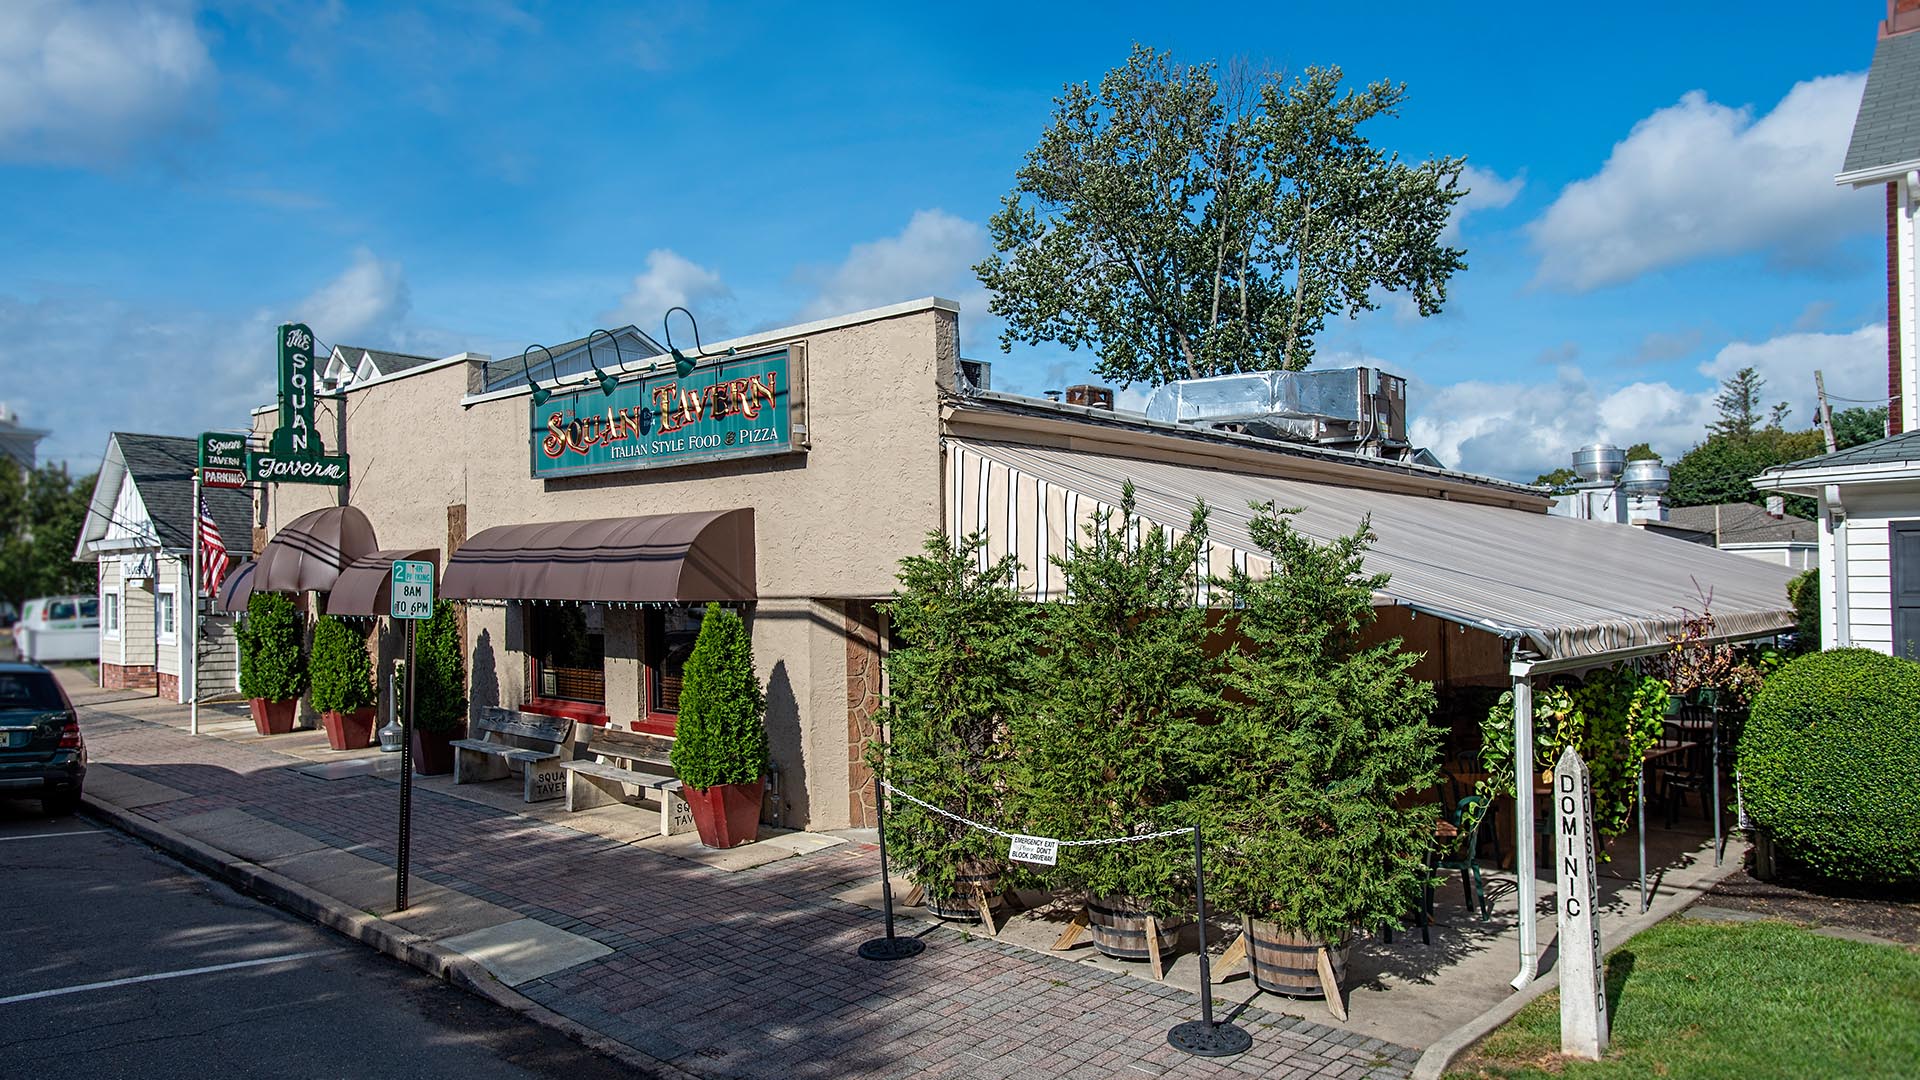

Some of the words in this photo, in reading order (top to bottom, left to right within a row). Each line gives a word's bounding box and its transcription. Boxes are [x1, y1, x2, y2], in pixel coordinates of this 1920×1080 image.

[286, 329, 310, 350] The
[292, 354, 307, 451] SQUAN
[653, 372, 777, 433] TAVERN
[611, 443, 648, 459] ITALIAN
[651, 438, 684, 454] STYLE
[688, 433, 721, 450] FOOD
[739, 426, 778, 444] PIZZA
[207, 455, 240, 467] TAVERN
[258, 458, 345, 478] Tavern
[204, 470, 243, 485] PARKING
[395, 565, 403, 579] 2
[395, 601, 406, 612] TO
[410, 602, 428, 613] 6PM
[538, 771, 566, 783] SQUA
[1014, 837, 1043, 846] EMERGENCY
[1560, 774, 1581, 918] DOMINIC
[1029, 853, 1053, 861] DRIVEWAY
